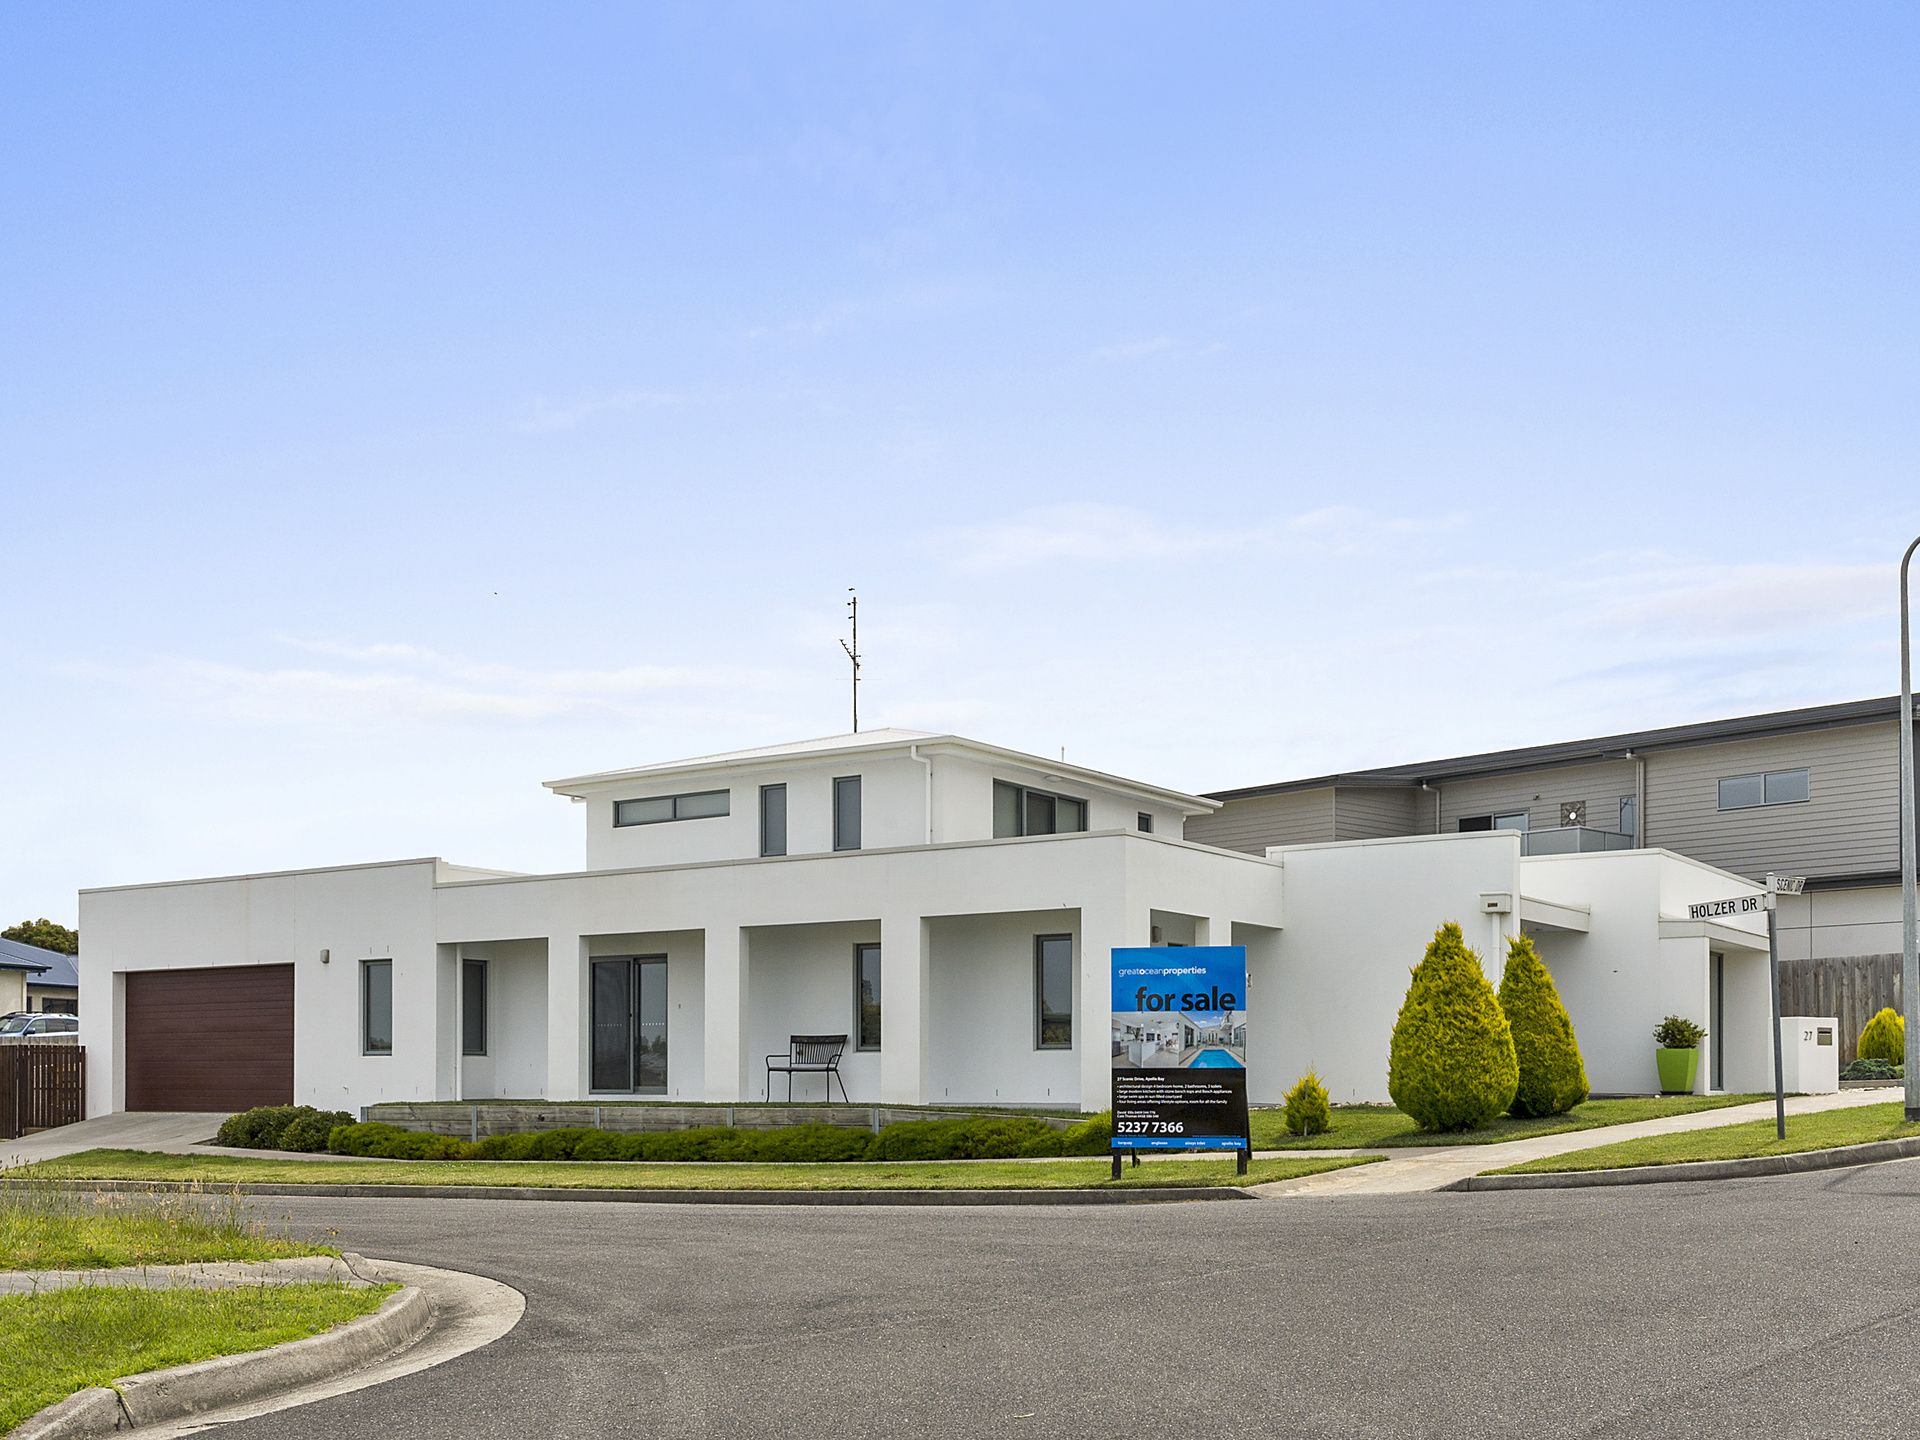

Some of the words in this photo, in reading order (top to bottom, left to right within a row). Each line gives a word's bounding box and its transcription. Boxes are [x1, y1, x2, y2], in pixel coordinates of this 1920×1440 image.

[1691, 901, 1736, 919] HOLZER
[1742, 898, 1757, 912] DR
[1118, 966, 1207, 977] greatoceanproperties
[1135, 986, 1176, 1012] for
[1181, 986, 1236, 1012] sale
[1803, 1031, 1813, 1041] 27
[1117, 1122, 1149, 1133] 5237
[1152, 1122, 1184, 1133] 7366
